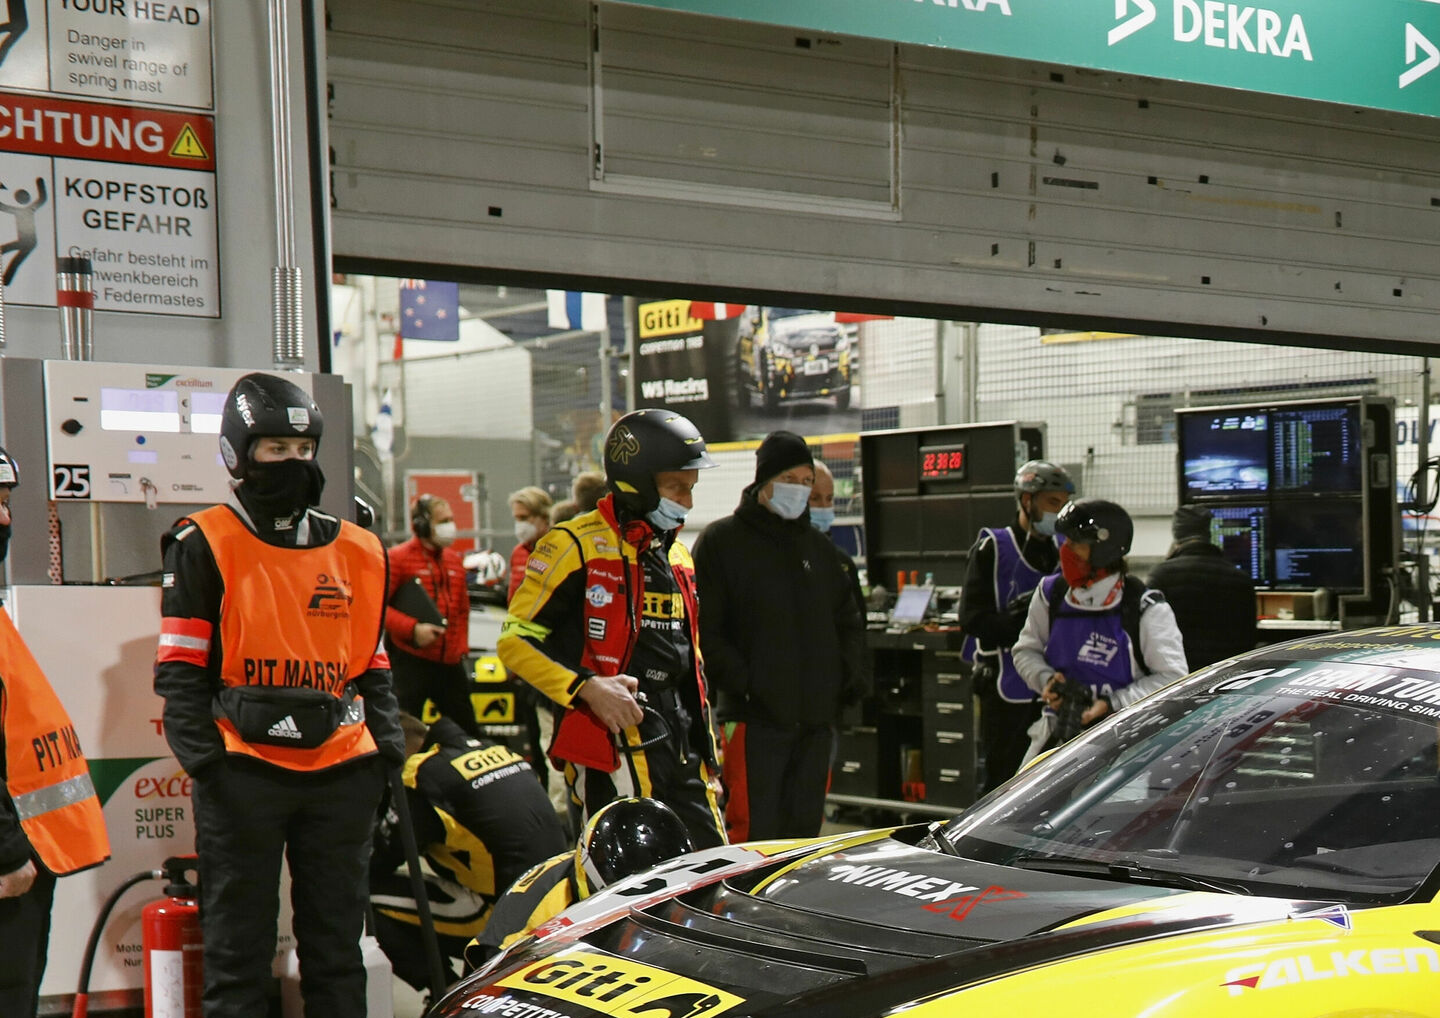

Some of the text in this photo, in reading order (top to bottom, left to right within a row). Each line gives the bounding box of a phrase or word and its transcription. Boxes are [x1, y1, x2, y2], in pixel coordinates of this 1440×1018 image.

[134, 1, 200, 26] HEAD
[67, 29, 146, 51] Danger in
[1173, 0, 1313, 61] DEKRA
[68, 51, 188, 77] swivel range of
[69, 72, 162, 94] spring mast
[64, 177, 209, 209] KOPFSTOß
[83, 209, 192, 237] GEFAHR
[68, 245, 209, 270] Gefahr besteht im
[105, 288, 205, 308] Federmastes
[644, 308, 681, 331] Giti
[641, 377, 709, 400] WS Racing
[55, 467, 90, 498] 25
[243, 658, 277, 686] PIT
[1288, 668, 1398, 695] GRAN
[1275, 687, 1305, 696] THE
[1305, 688, 1342, 701] REAL
[1344, 692, 1410, 711] DRIVING
[268, 727, 302, 740] adidas
[32, 730, 62, 772] PIT
[464, 749, 505, 772] Giti
[135, 807, 185, 823] SUPER
[136, 824, 175, 839] PLUS
[523, 960, 653, 1003] Giti
[1222, 946, 1440, 998] FALKEN
